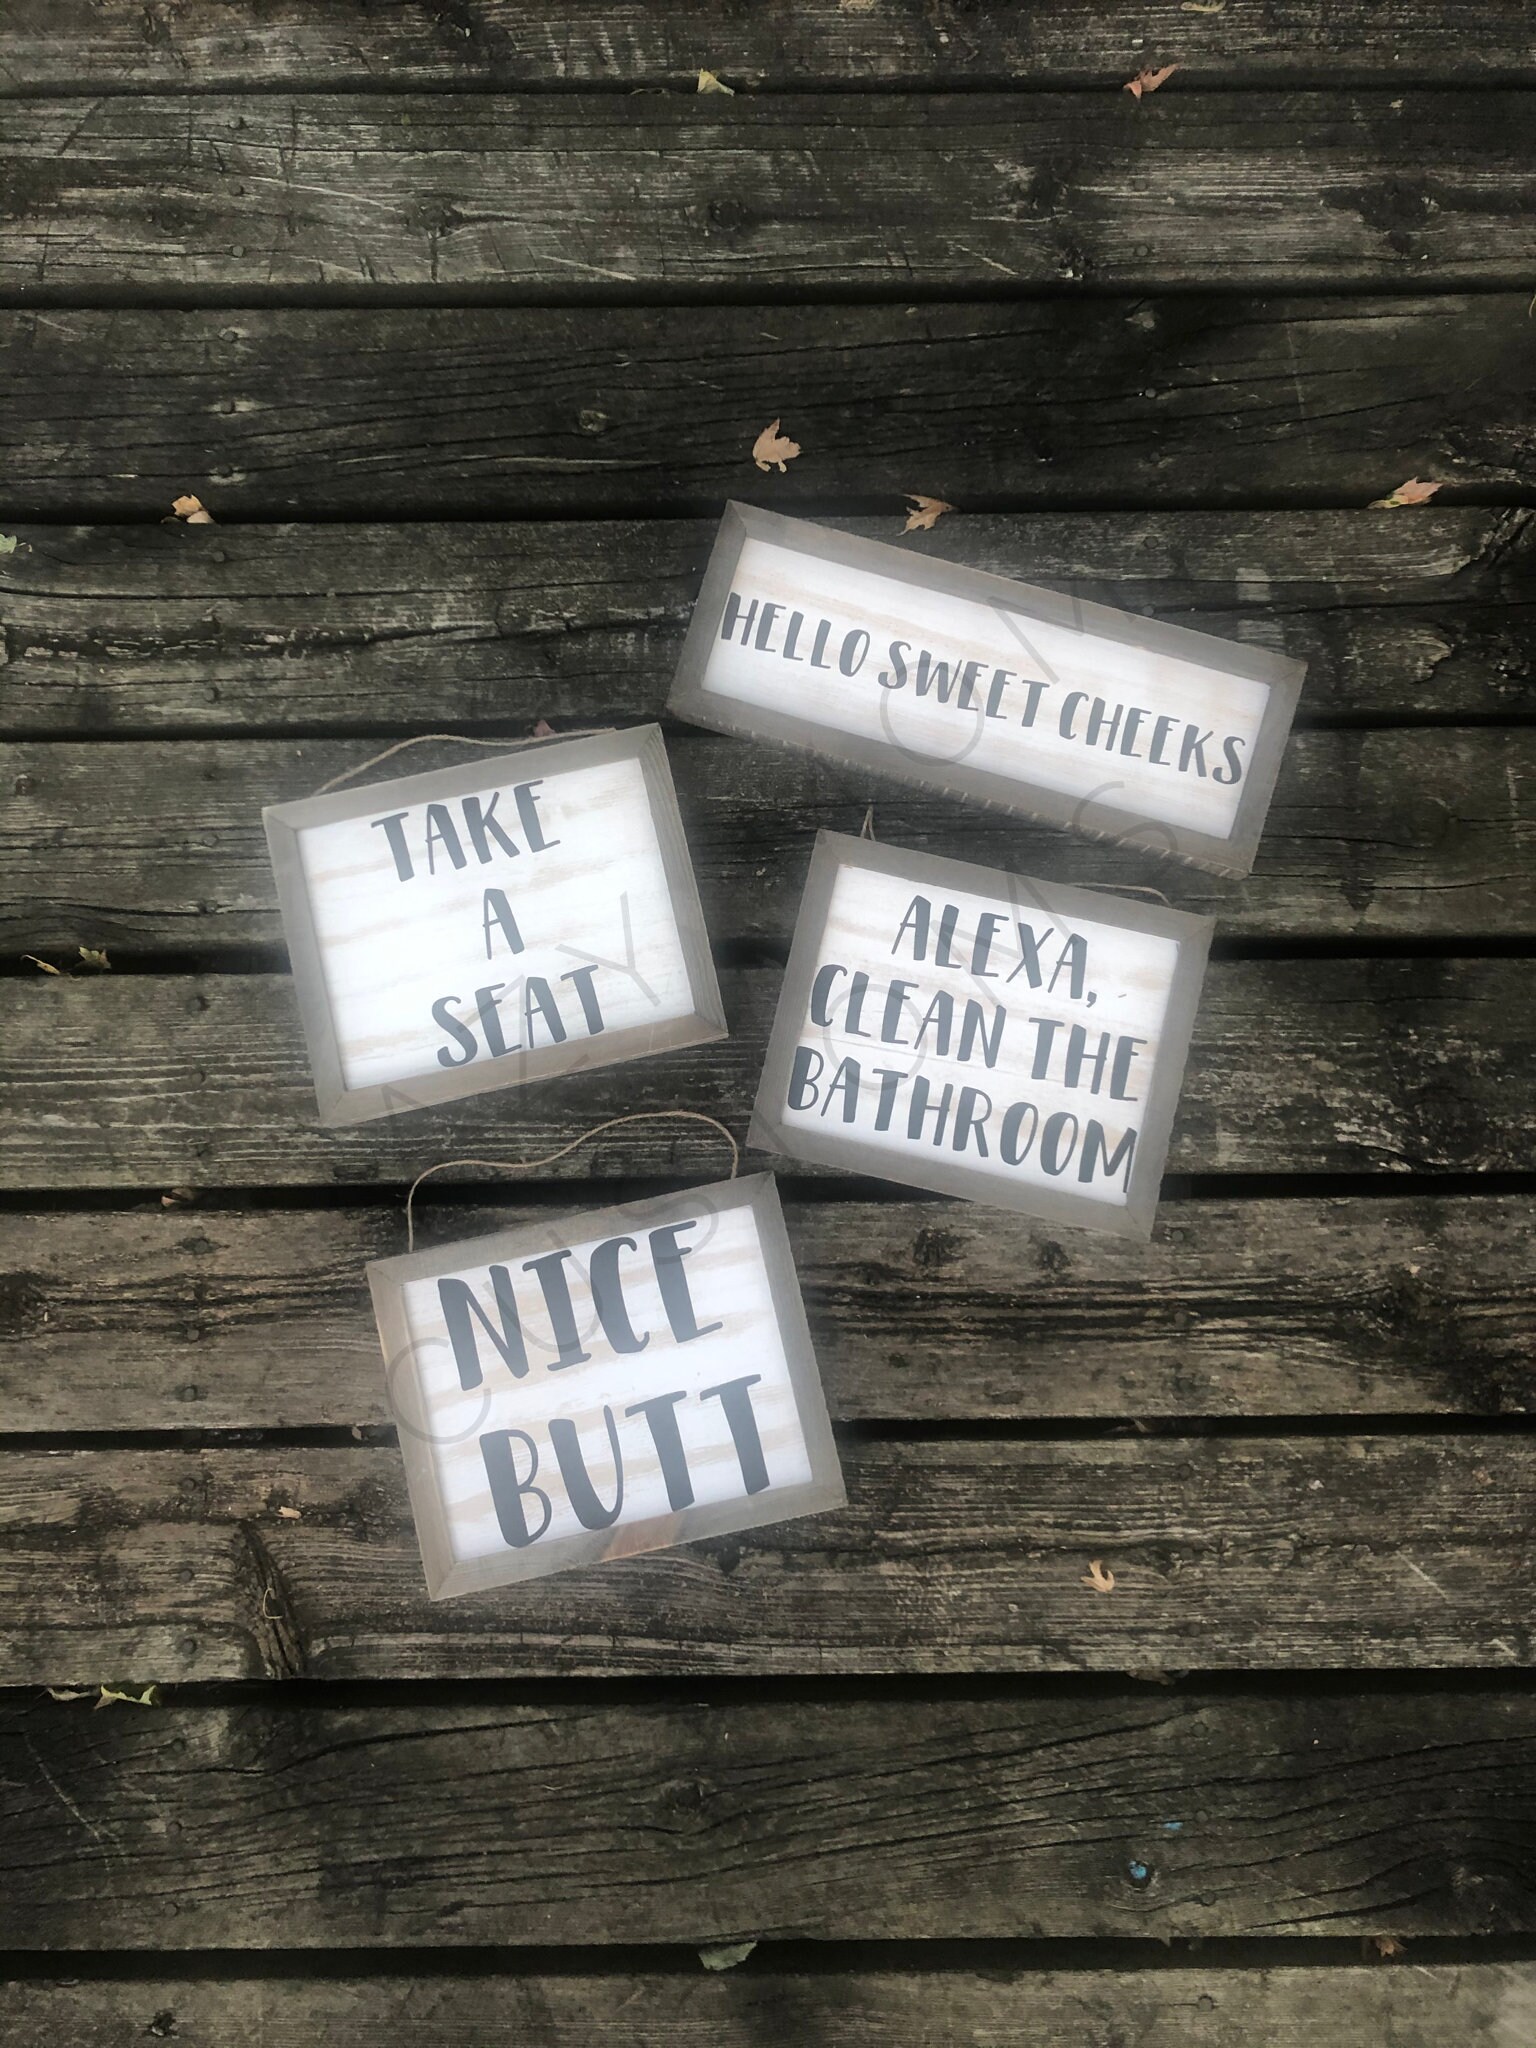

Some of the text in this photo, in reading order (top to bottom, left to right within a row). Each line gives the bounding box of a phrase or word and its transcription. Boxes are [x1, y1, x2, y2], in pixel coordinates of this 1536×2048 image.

[720, 592, 1246, 786] HELLO SWEET CHEEKS
[370, 779, 561, 882] TAKE
[482, 888, 525, 960] A
[891, 895, 1097, 1007] ALEXA,
[431, 964, 605, 1068] SEAT
[811, 964, 1148, 1101] CLEAN THE
[787, 1046, 1138, 1193] BATHROOM
[437, 1220, 724, 1391] NICE
[479, 1374, 771, 1548] BUTT
